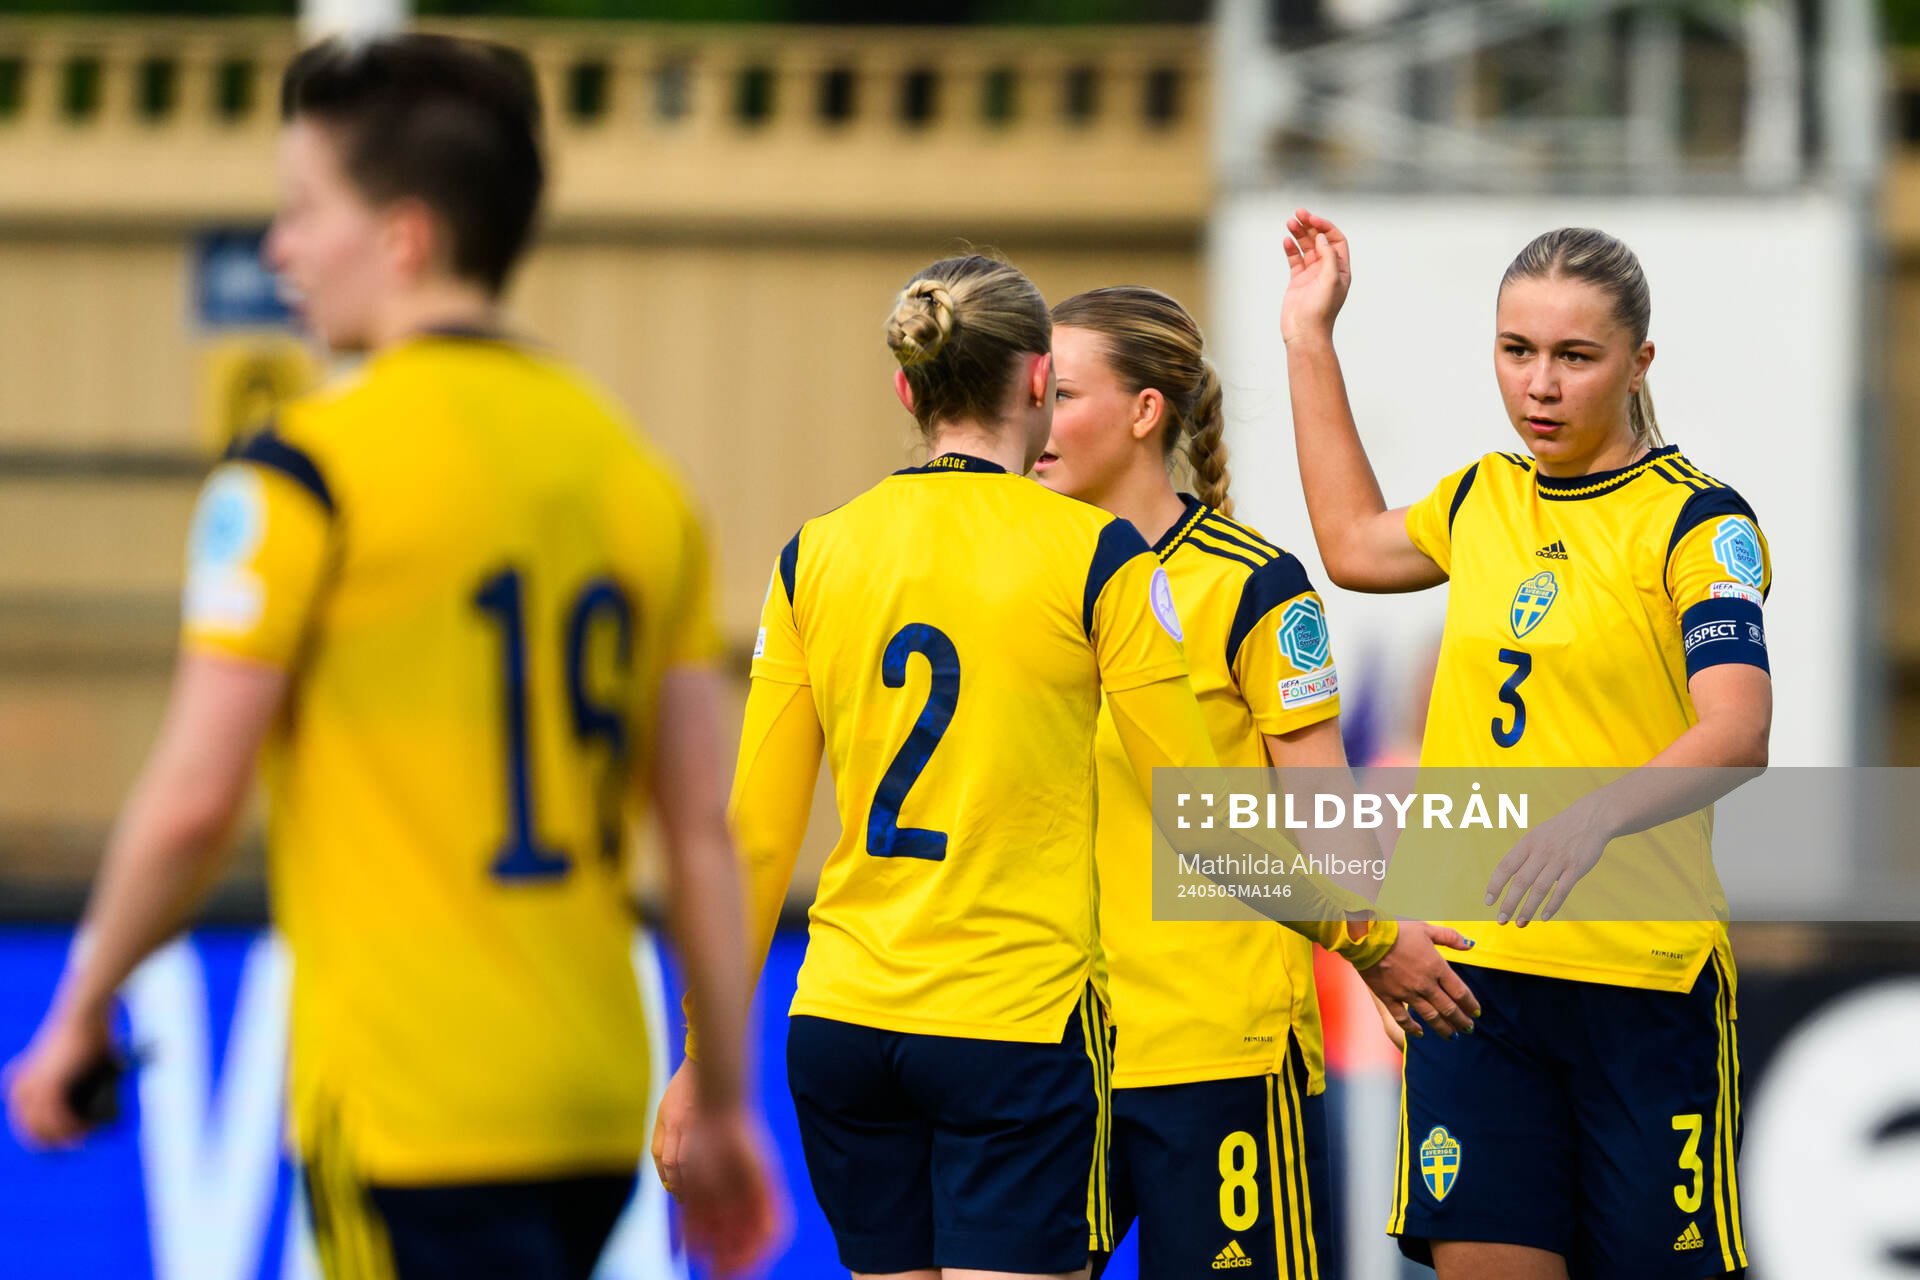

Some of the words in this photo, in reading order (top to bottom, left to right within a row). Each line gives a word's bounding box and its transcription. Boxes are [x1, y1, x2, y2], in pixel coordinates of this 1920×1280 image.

[1535, 550, 1569, 560] adidas
[1685, 624, 1737, 652] RESPECT
[1281, 679, 1300, 689] UEFA
[1491, 648, 1532, 748] 3
[866, 622, 961, 862] 2
[1425, 1148, 1454, 1156] SVERIGE
[1672, 1113, 1704, 1213] 3
[1218, 1130, 1259, 1232] 8
[1673, 1239, 1704, 1251] adidas
[1211, 1257, 1252, 1270] adidas
